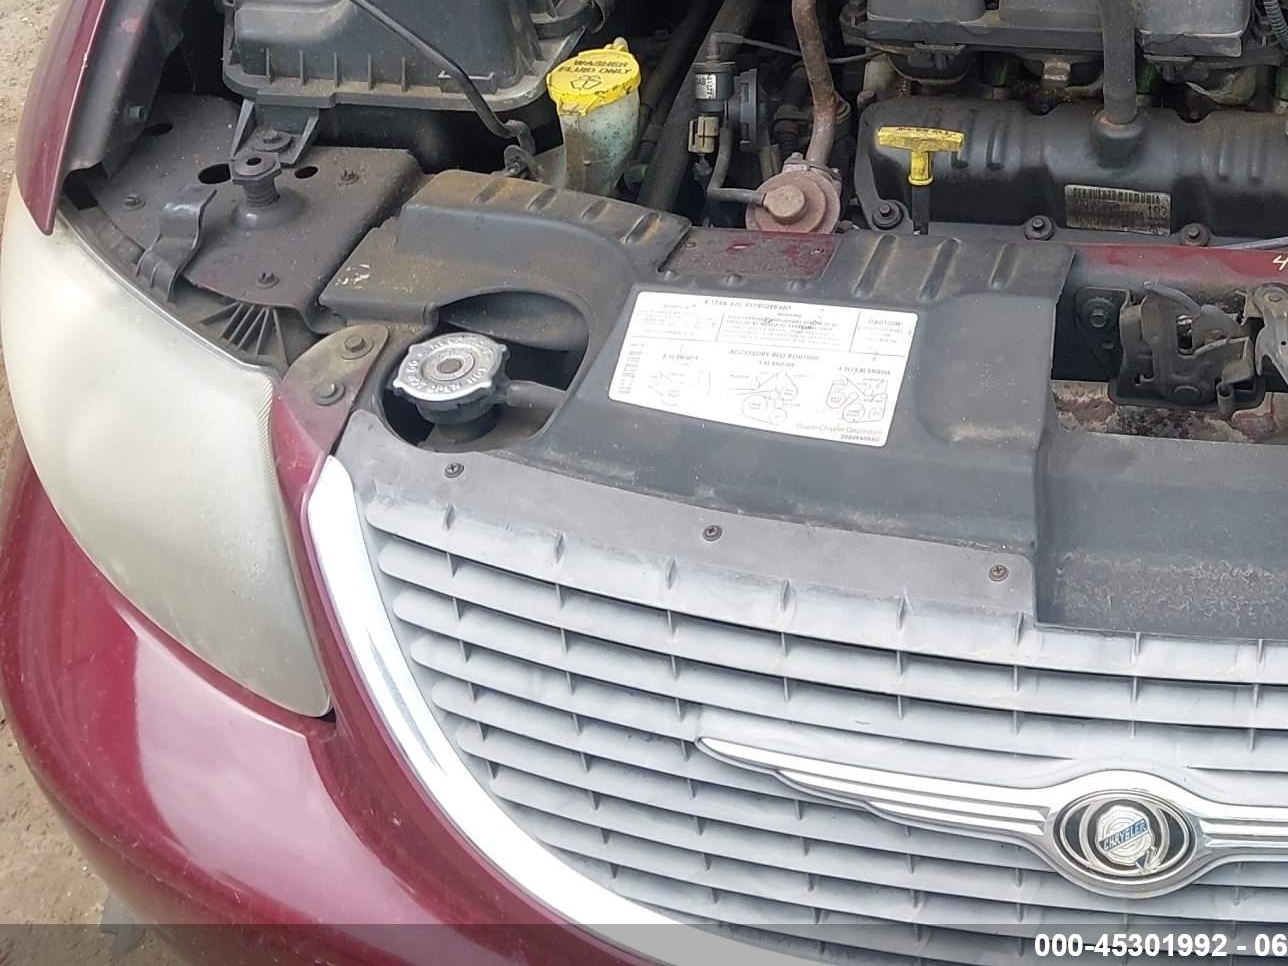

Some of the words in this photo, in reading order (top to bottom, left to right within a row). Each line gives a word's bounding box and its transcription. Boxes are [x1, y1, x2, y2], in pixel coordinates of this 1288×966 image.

[574, 59, 629, 68] WASHER
[558, 65, 596, 74] FLUID
[1103, 820, 1148, 851] CHRYSLER
